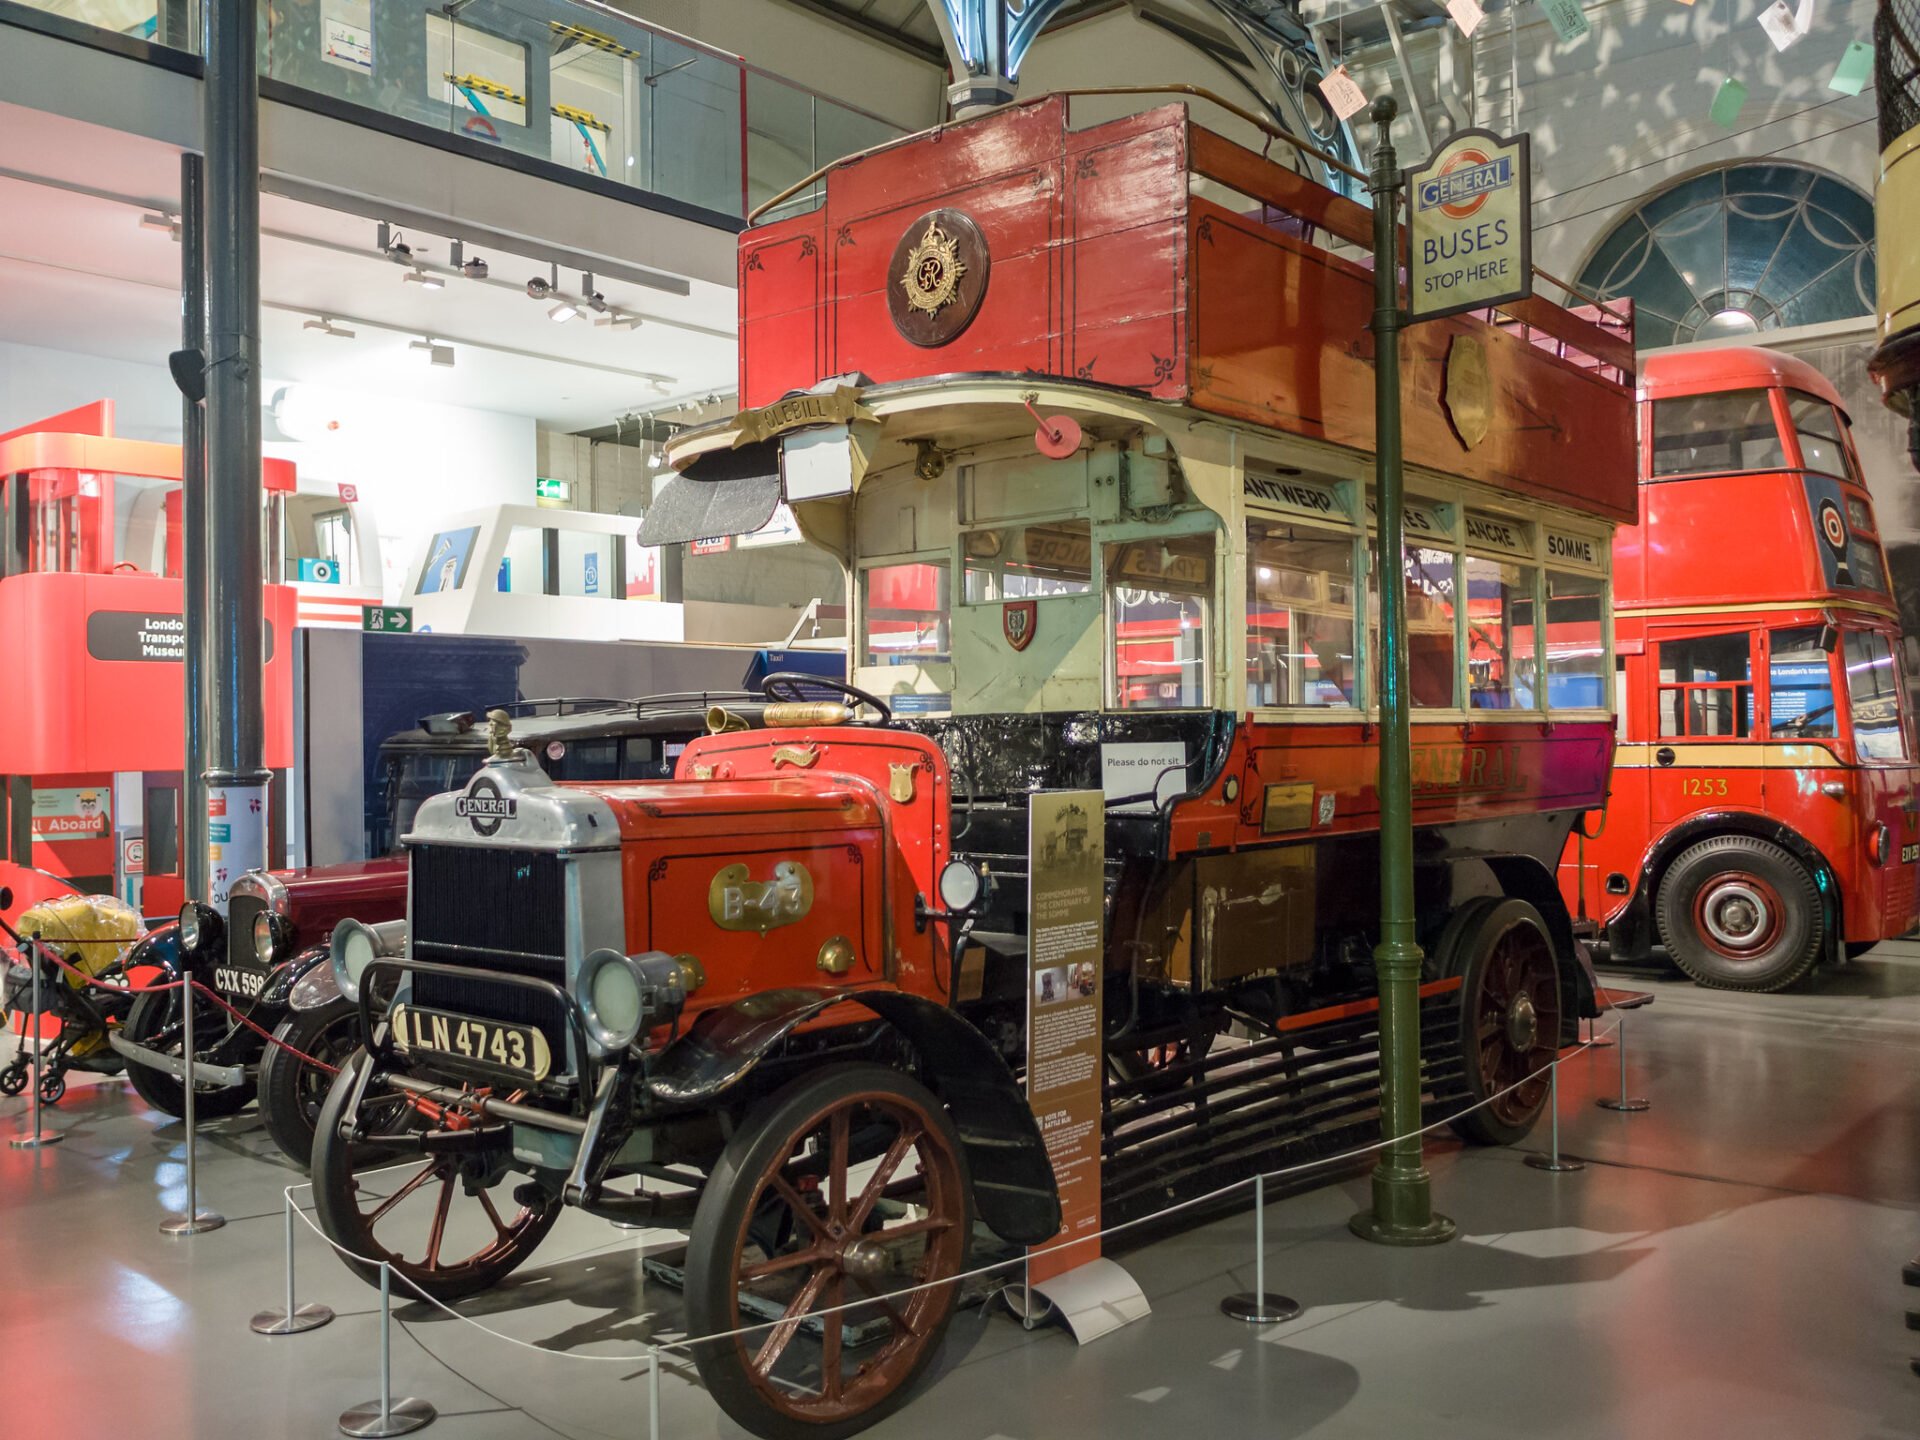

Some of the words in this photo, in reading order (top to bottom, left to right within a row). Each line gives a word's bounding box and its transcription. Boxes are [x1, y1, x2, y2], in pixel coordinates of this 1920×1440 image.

[1421, 162, 1508, 206] GENERAL
[1424, 219, 1508, 265] BUSES
[1424, 269, 1463, 293] STOP
[1466, 257, 1508, 283] HERE
[1244, 478, 1331, 513] ANTWERP
[1466, 519, 1516, 548] ANCRE
[1548, 535, 1592, 561] SOMME
[145, 618, 184, 631] Londo
[138, 631, 184, 646] Transpo
[143, 645, 184, 657] Museu
[1107, 758, 1135, 767] Please
[1137, 757, 1149, 766] do
[1151, 757, 1165, 766] not
[1168, 757, 1179, 765] sit
[1683, 778, 1728, 796] 1253
[456, 797, 517, 818] GENERAL
[49, 817, 101, 831] Aboard
[215, 968, 240, 993] CXX
